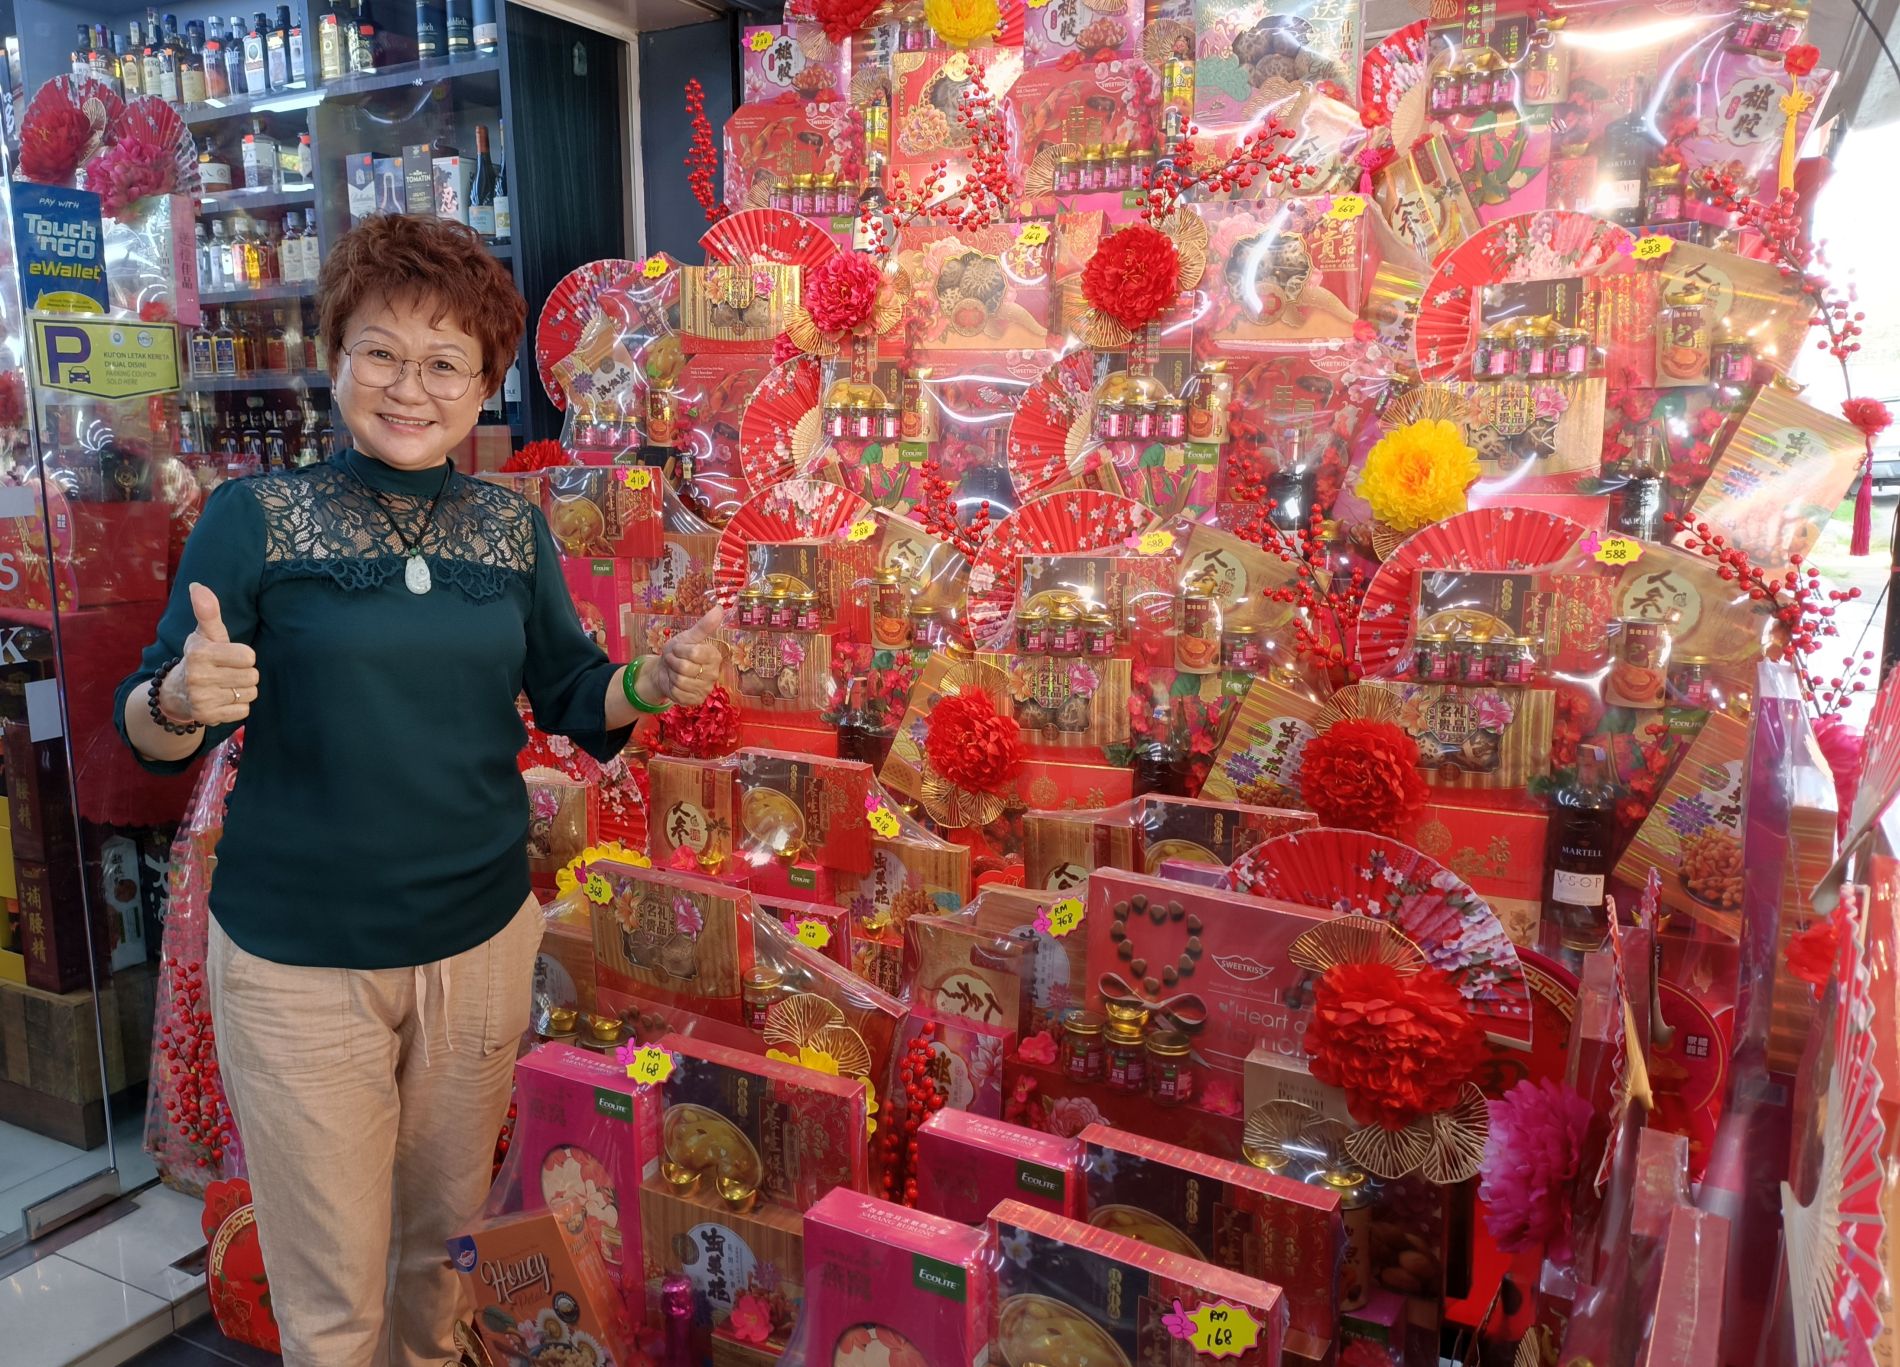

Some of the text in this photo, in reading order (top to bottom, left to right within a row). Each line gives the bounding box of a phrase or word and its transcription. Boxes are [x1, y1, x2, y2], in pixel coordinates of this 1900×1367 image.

[406, 176, 431, 184] TOMATIN
[39, 197, 80, 209] PAY WITH
[23, 213, 97, 240] Touch
[1641, 245, 1662, 256] 588
[29, 260, 101, 280] eWallet
[148, 353, 170, 361] KERETA
[630, 475, 646, 486] 418
[854, 527, 869, 537] 588
[1605, 550, 1627, 560] 588
[884, 811, 894, 821] RM
[874, 815, 889, 832] 418
[593, 875, 603, 885] RM
[588, 884, 602, 898] 368
[1054, 903, 1068, 916] RM
[1056, 912, 1073, 927] 768
[805, 931, 816, 939] 168
[1220, 959, 1265, 976] SWEETKISS
[1234, 1004, 1289, 1031] Heart
[647, 1051, 661, 1061] RM
[641, 1060, 660, 1076] 168
[598, 1097, 627, 1113] ECOLITE
[1021, 1171, 1057, 1191] ECOLITE
[862, 1212, 895, 1225] SARANG
[896, 1222, 935, 1238] BURUNG
[479, 1251, 552, 1305] Honey
[918, 1267, 957, 1291] ECOLITE
[1209, 1310, 1229, 1323] RM
[1206, 1328, 1233, 1347] 168
